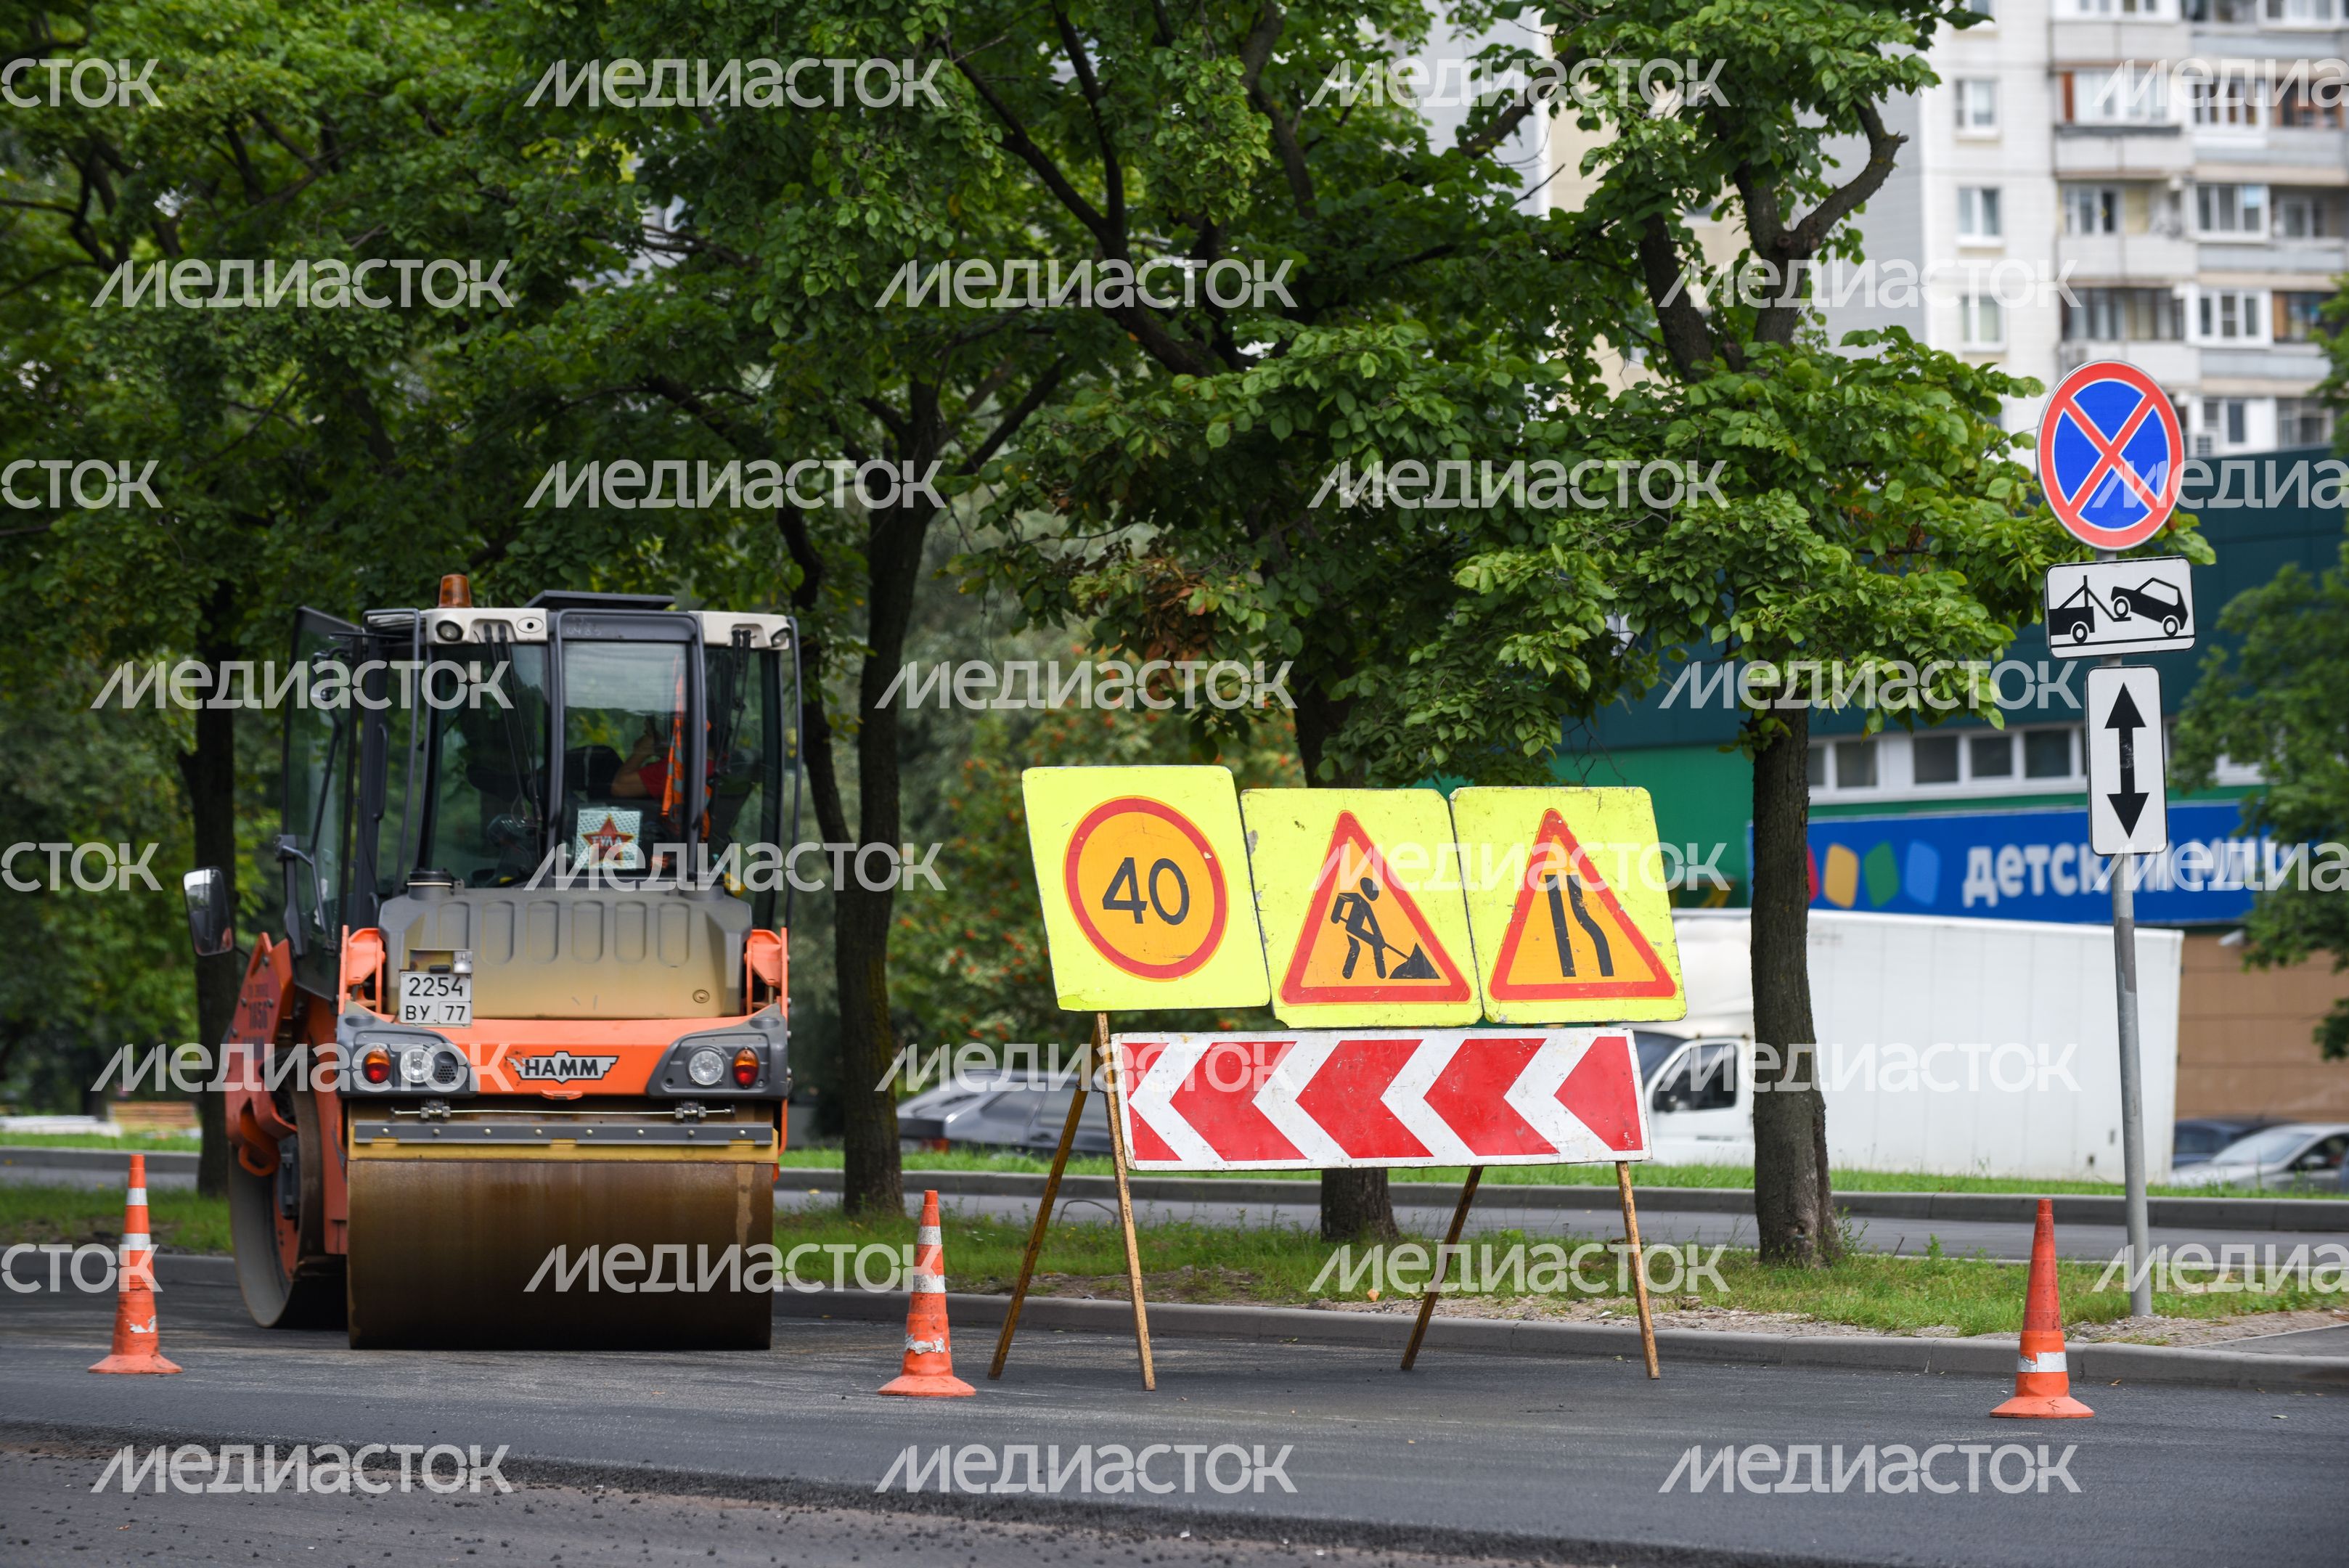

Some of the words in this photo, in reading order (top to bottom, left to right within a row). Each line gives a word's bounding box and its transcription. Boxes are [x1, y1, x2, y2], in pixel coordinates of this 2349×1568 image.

[1102, 857, 1190, 926] 40
[409, 976, 463, 997] 2254
[445, 1005, 466, 1021] 77
[525, 1059, 599, 1076] HAMM
